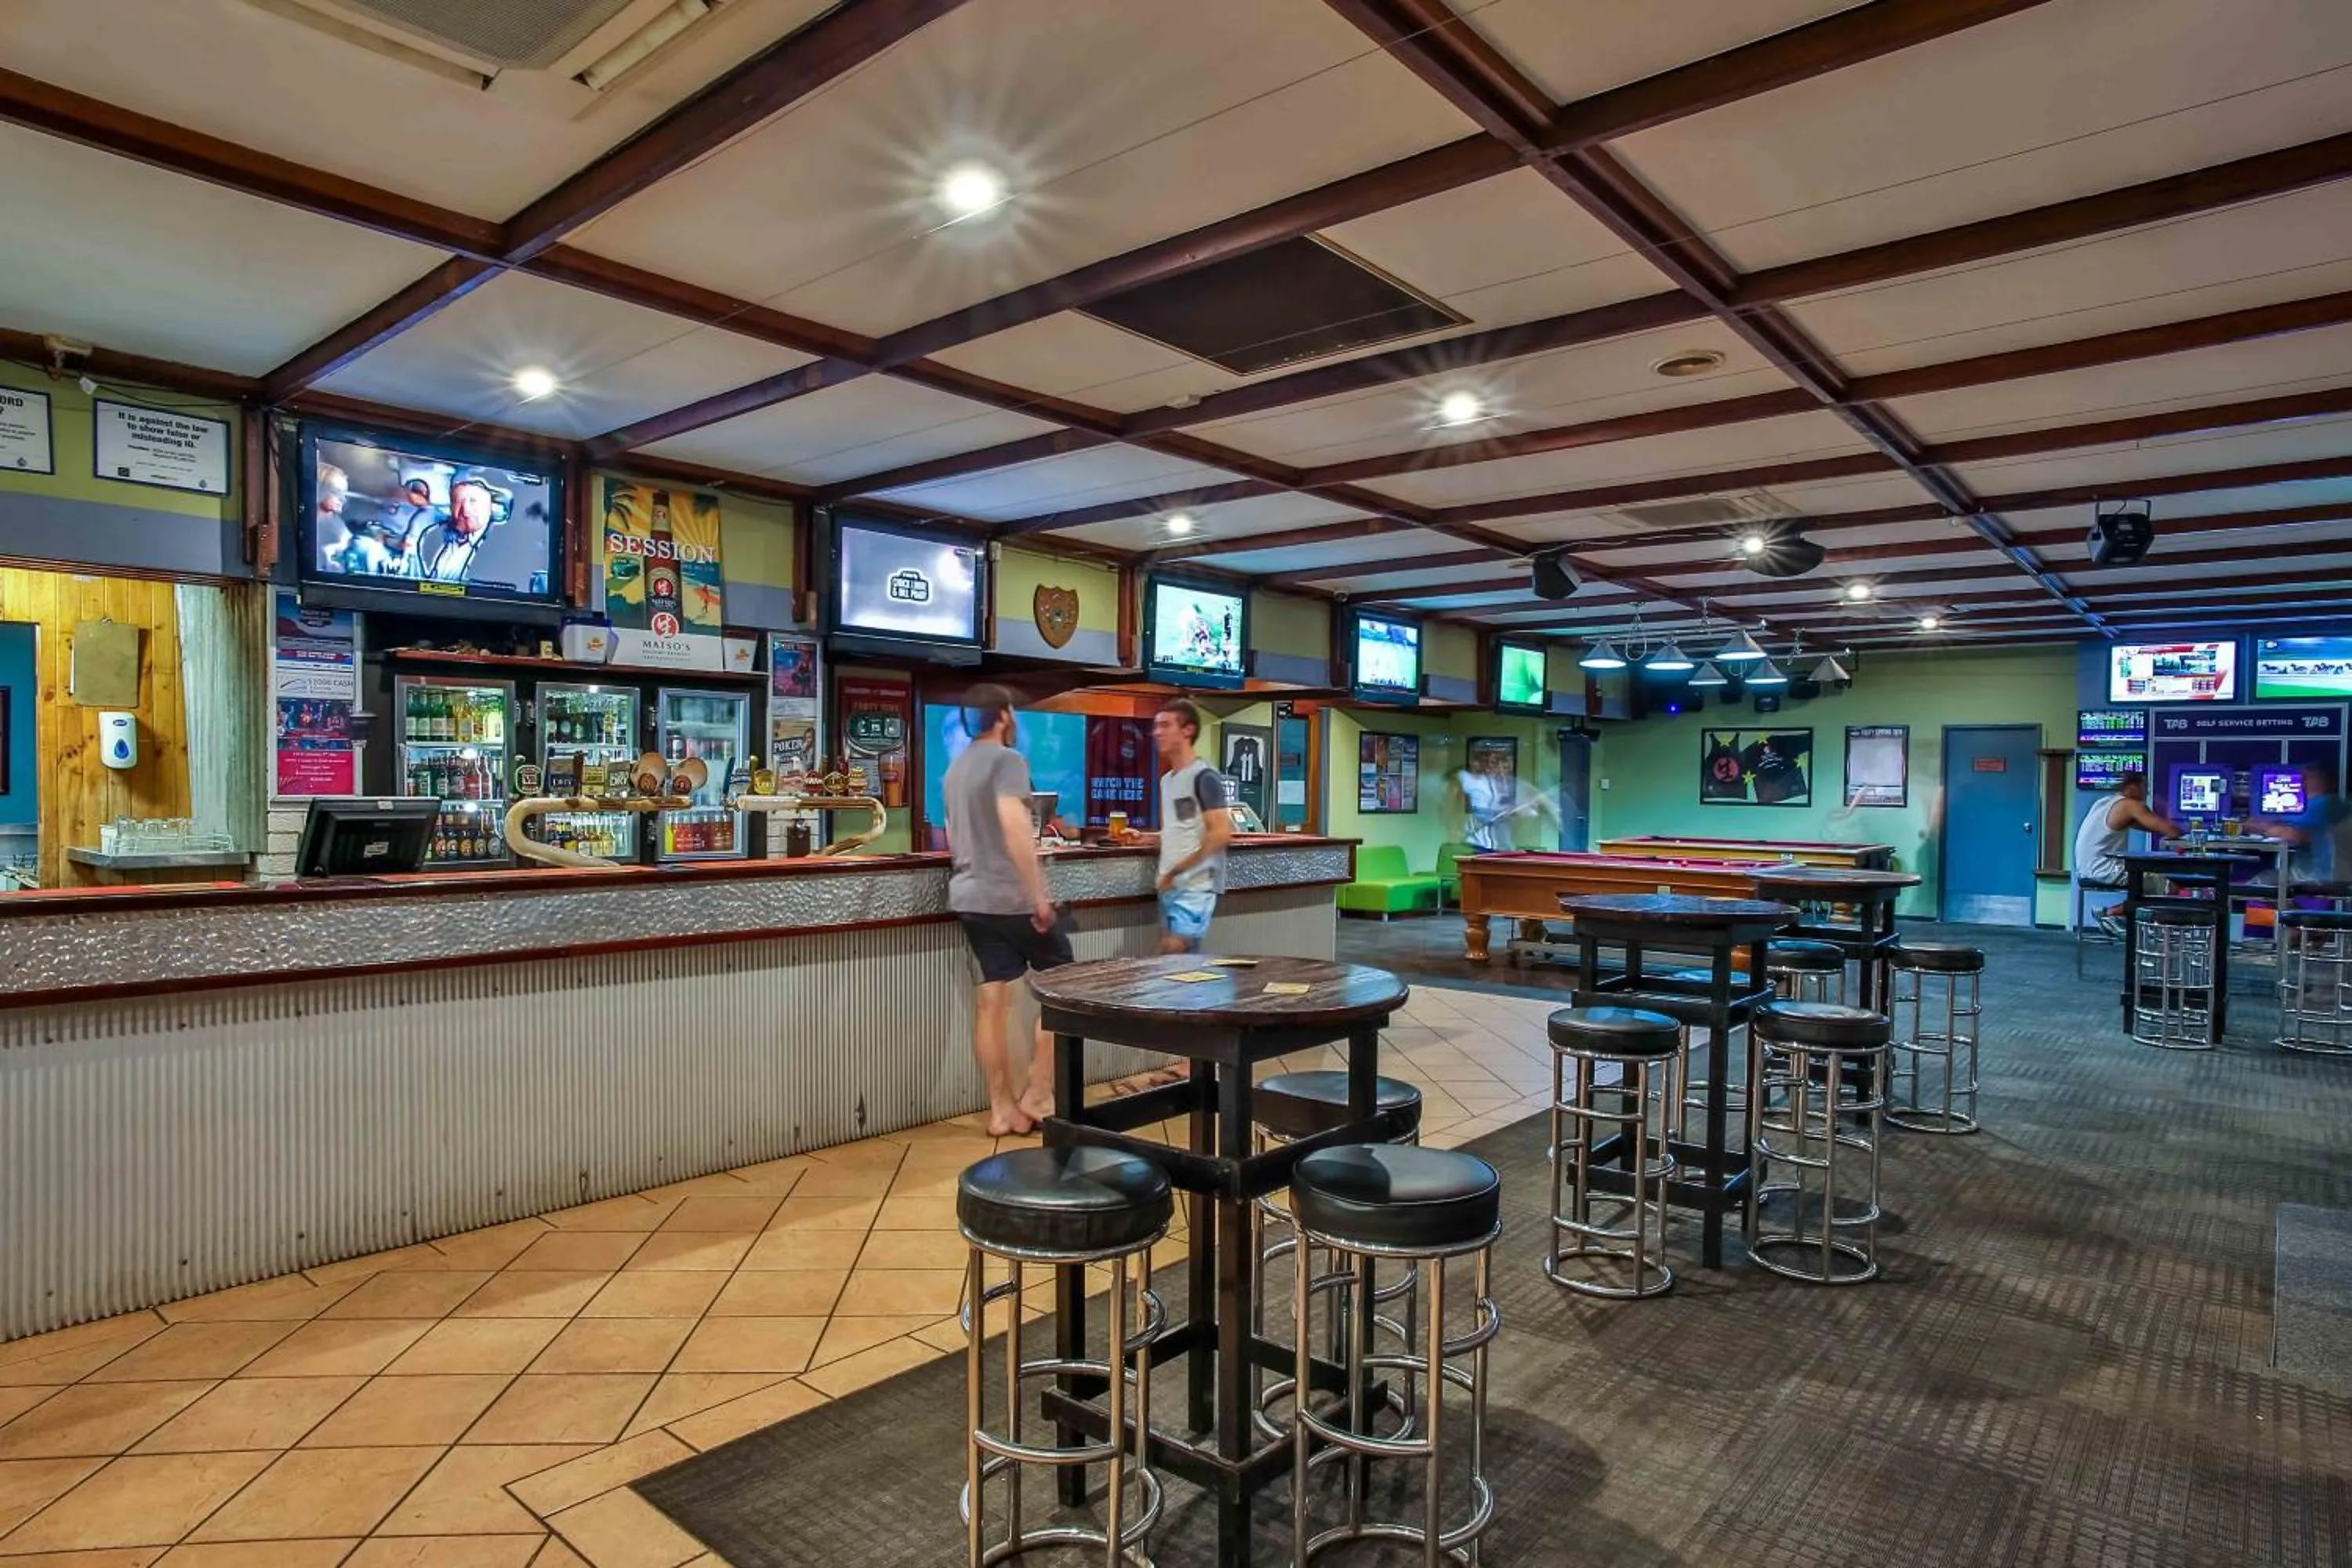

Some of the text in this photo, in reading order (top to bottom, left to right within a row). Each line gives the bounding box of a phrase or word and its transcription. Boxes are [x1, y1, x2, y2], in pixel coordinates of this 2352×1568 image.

[127, 422, 136, 430] to
[139, 424, 164, 434] show
[166, 427, 189, 438] false
[139, 416, 173, 428] against
[176, 422, 190, 430] the
[192, 424, 209, 434] law
[131, 432, 182, 448] misleading
[609, 533, 717, 564] SESSION
[642, 641, 691, 652] MATSO'S
[2164, 719, 2188, 729] TAB
[2256, 718, 2293, 727] BETTING
[2301, 717, 2330, 728] TAB
[1091, 777, 1144, 789] WATCH THE
[1091, 788, 1143, 800] GAME HERE
